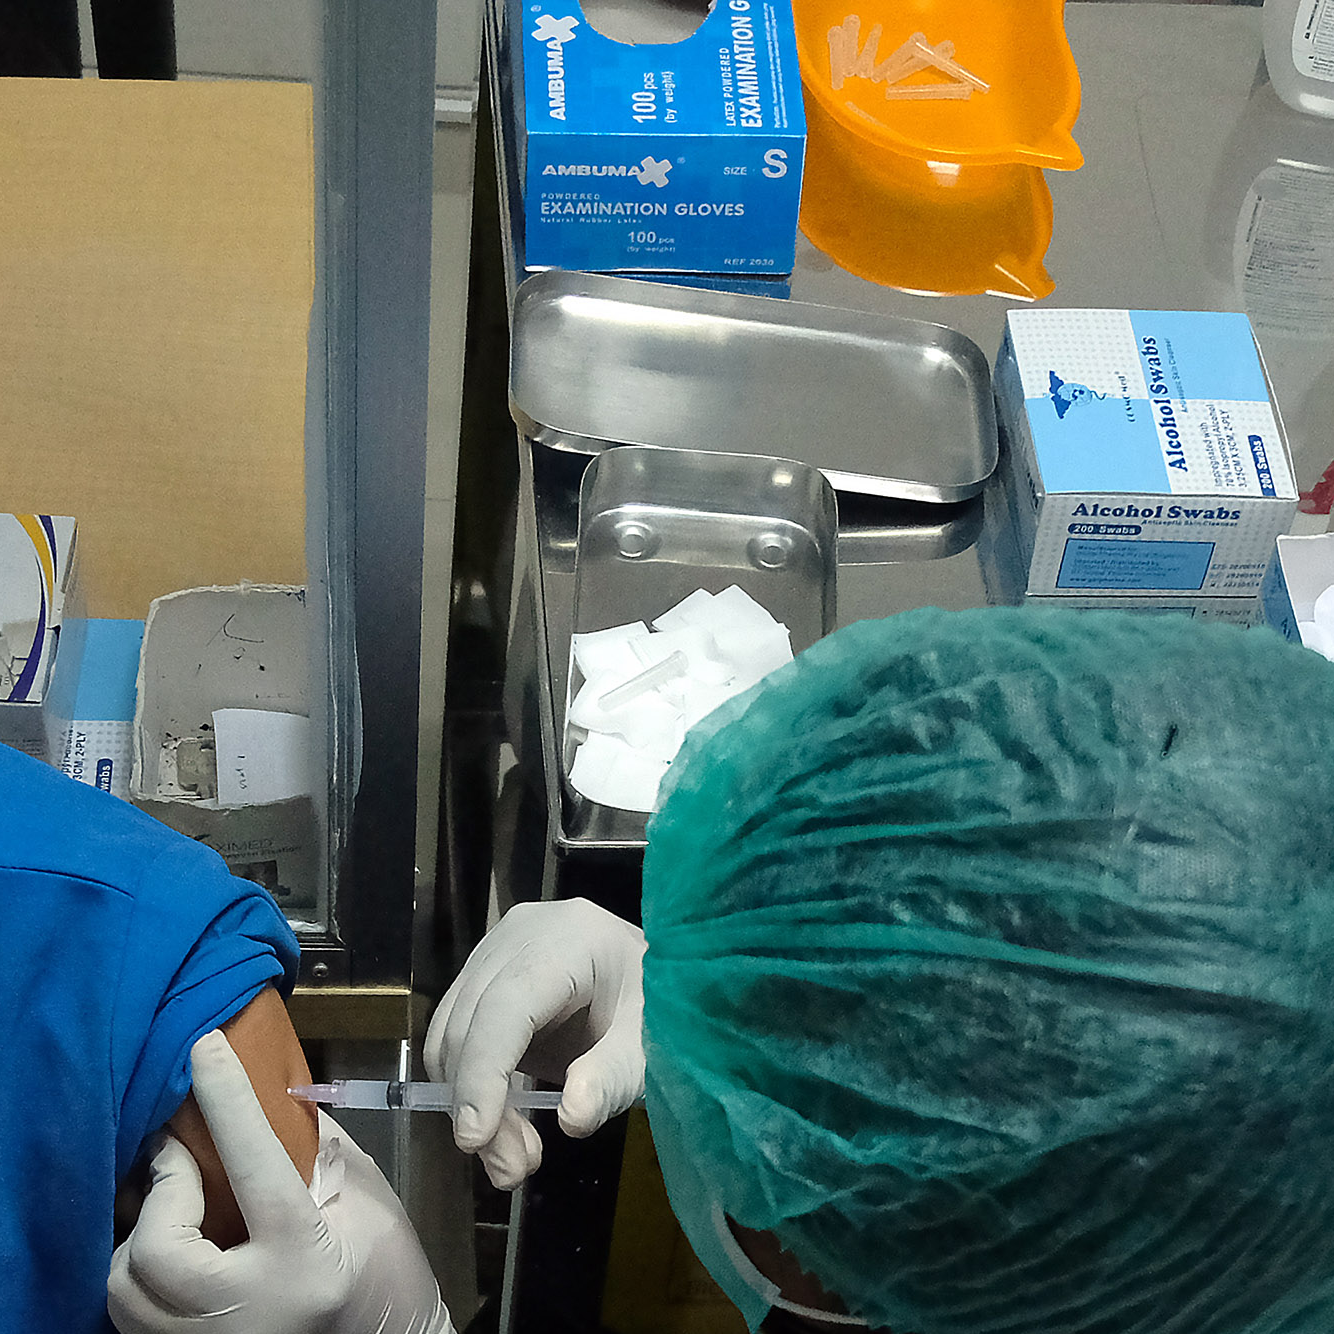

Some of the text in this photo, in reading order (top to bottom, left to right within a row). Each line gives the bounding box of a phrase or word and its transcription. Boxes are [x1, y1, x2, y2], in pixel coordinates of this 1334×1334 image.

[719, 47, 736, 127] LATEX POWDERED
[731, 16, 763, 129] EXAMINATION
[632, 72, 658, 123] 100 pcs
[661, 71, 677, 123] (by weight)
[723, 149, 788, 179] SIZE S
[540, 202, 745, 217] EXAMINATION GLOVES
[627, 231, 657, 244] 100
[1141, 335, 1188, 472] Alcohol Swabs
[1199, 422, 1211, 438] with
[1251, 440, 1273, 490] 200 Swabs
[1072, 502, 1241, 521] Alcohol Swabs
[1074, 525, 1136, 534] 200 Swabs
[74, 731, 87, 757] 2-PLY
